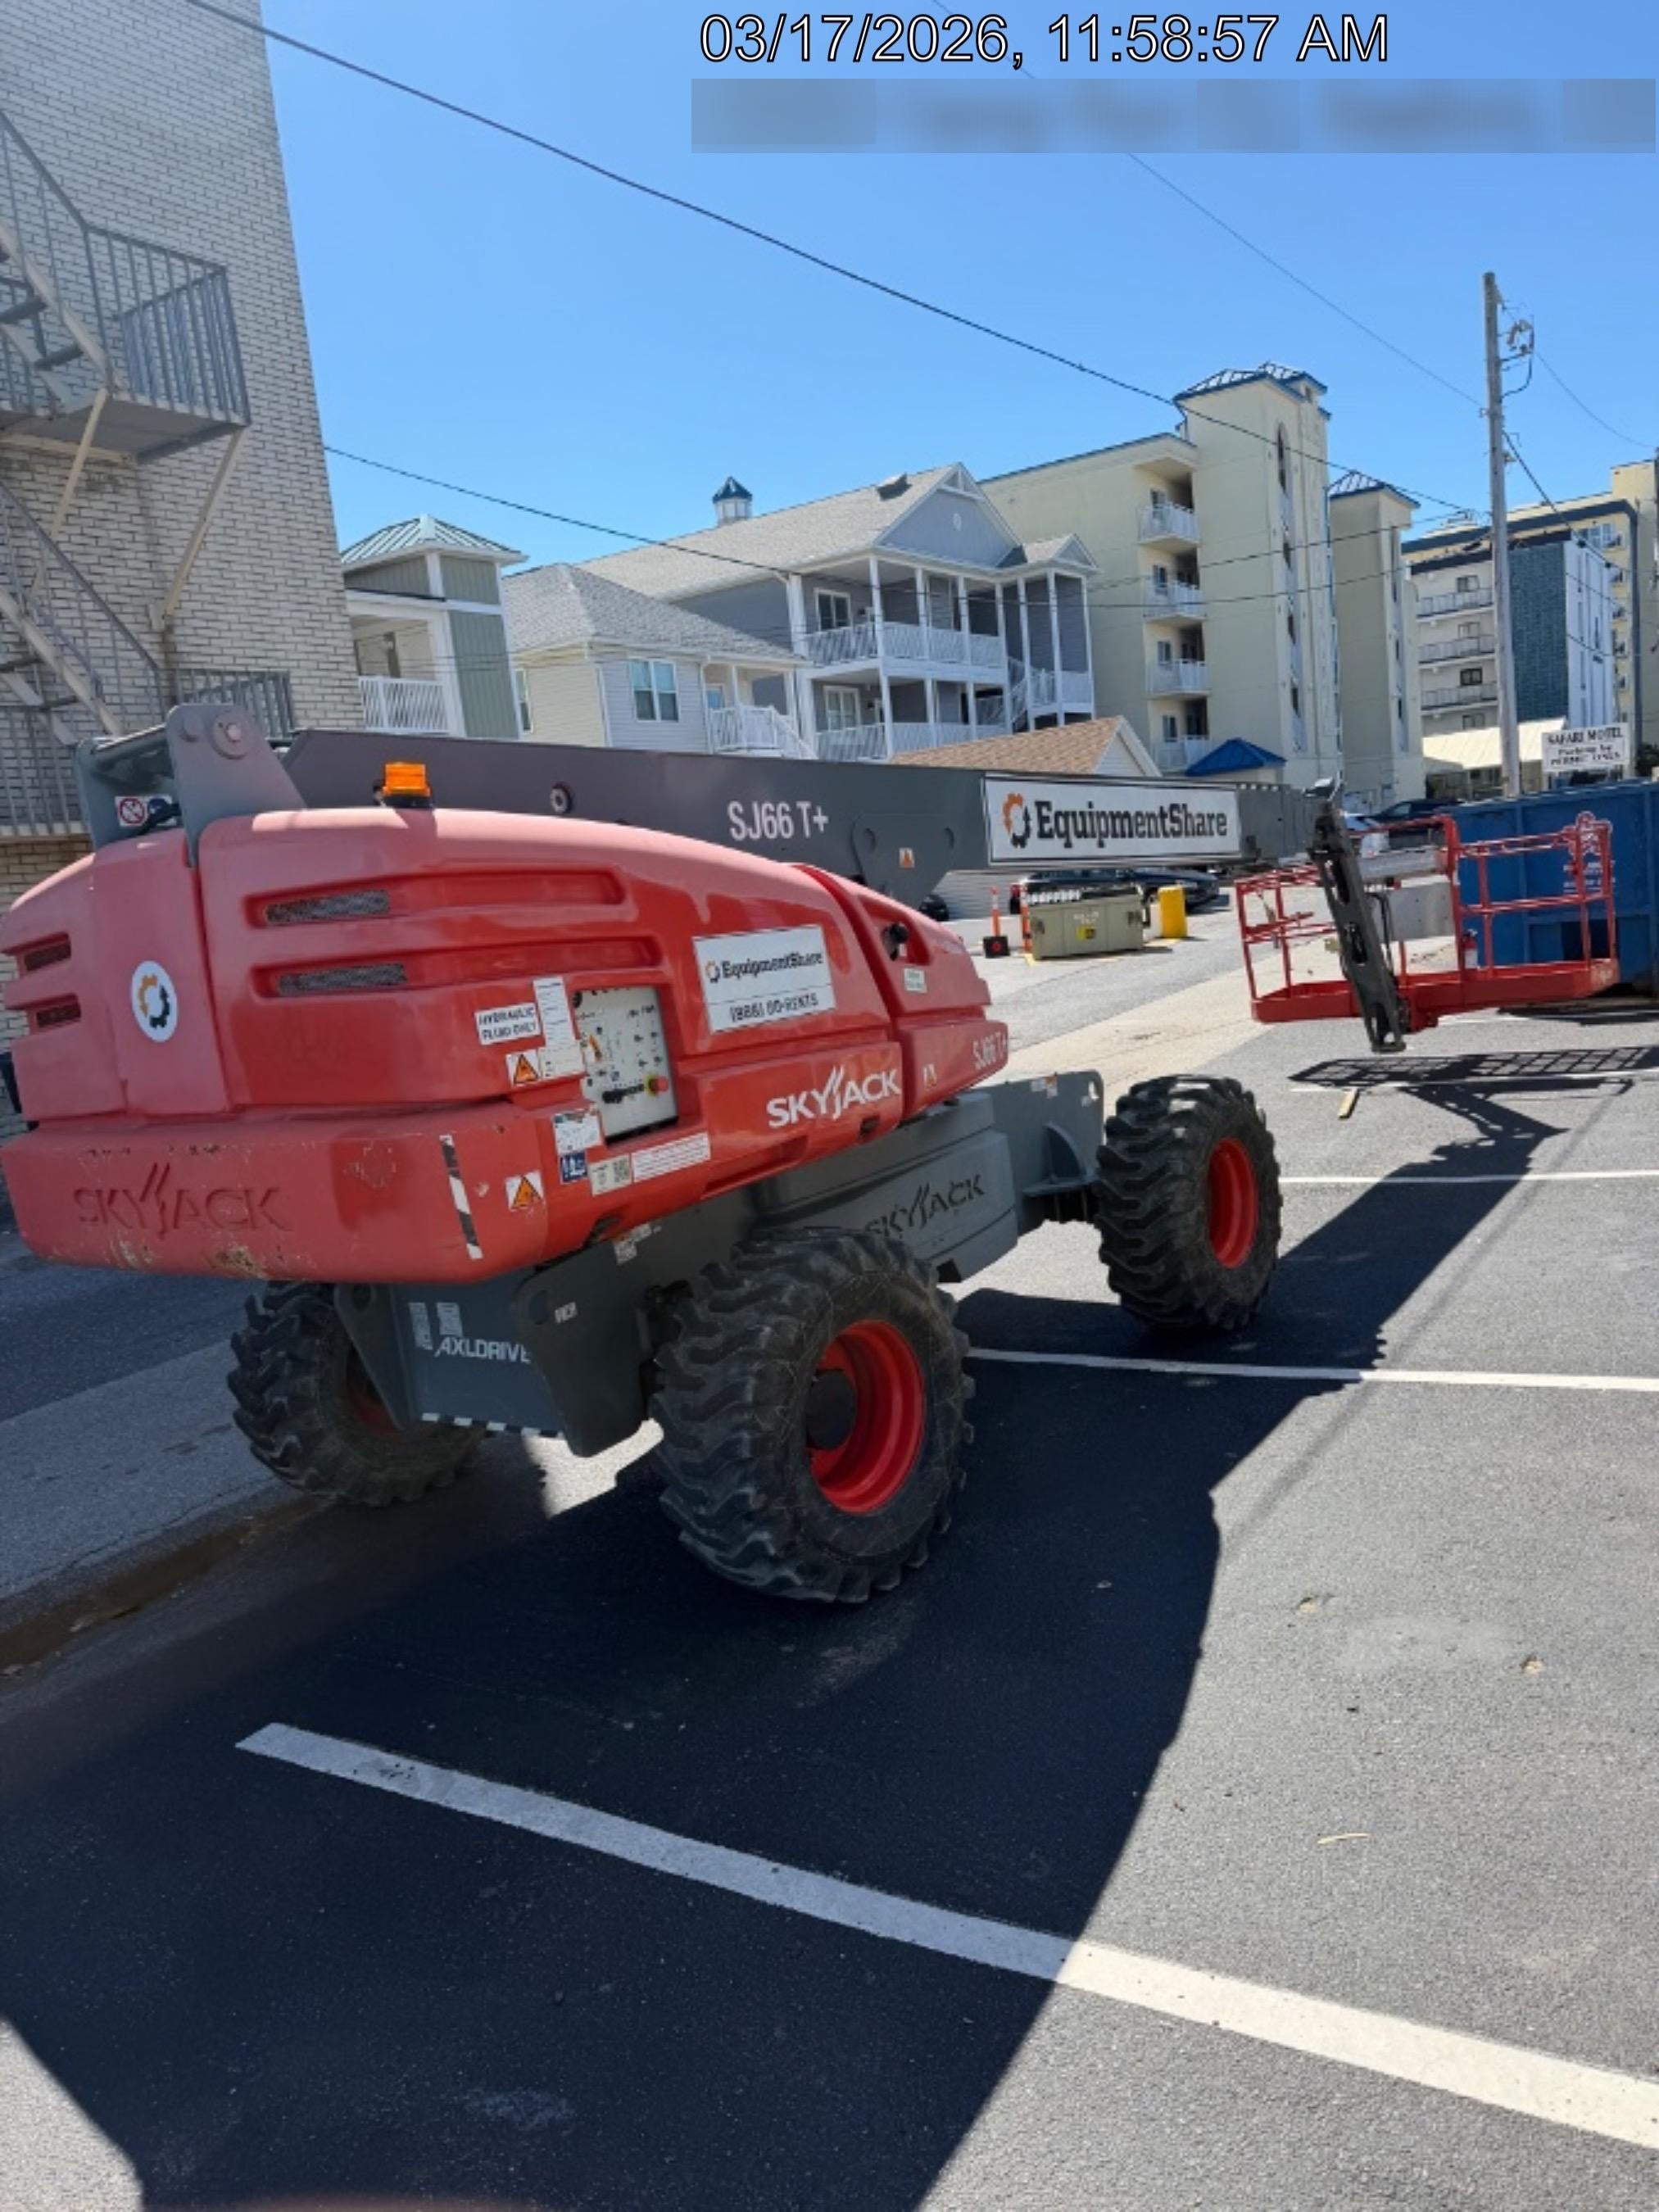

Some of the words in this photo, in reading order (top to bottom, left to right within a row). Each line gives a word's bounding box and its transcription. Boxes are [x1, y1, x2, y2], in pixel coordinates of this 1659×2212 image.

[727, 800, 795, 841] SJ66
[796, 800, 829, 839] T+
[1034, 800, 1227, 849] EquipmentShare
[721, 951, 824, 980] EquipmentShare
[766, 1064, 902, 1129] SKYJACK
[72, 1162, 294, 1240] SKYJACK
